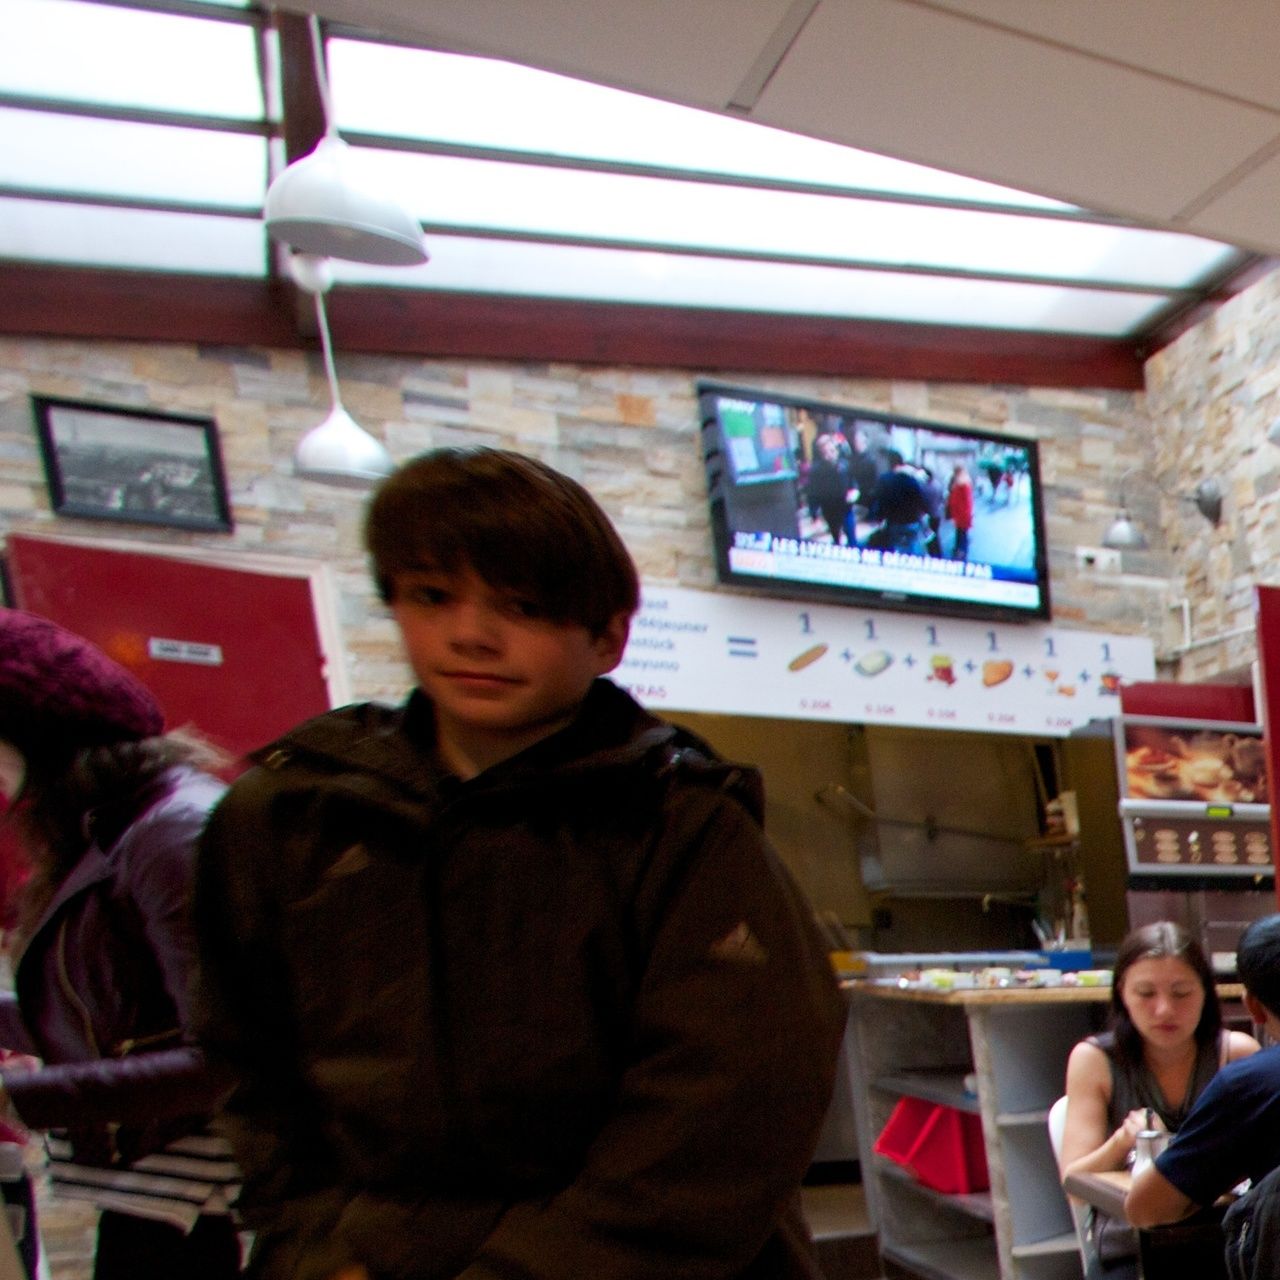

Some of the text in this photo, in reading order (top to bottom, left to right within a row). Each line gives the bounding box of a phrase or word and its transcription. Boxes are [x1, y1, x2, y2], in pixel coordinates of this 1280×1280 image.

[773, 537, 799, 555] LES
[862, 548, 881, 566] NE
[965, 562, 993, 580] PAS
